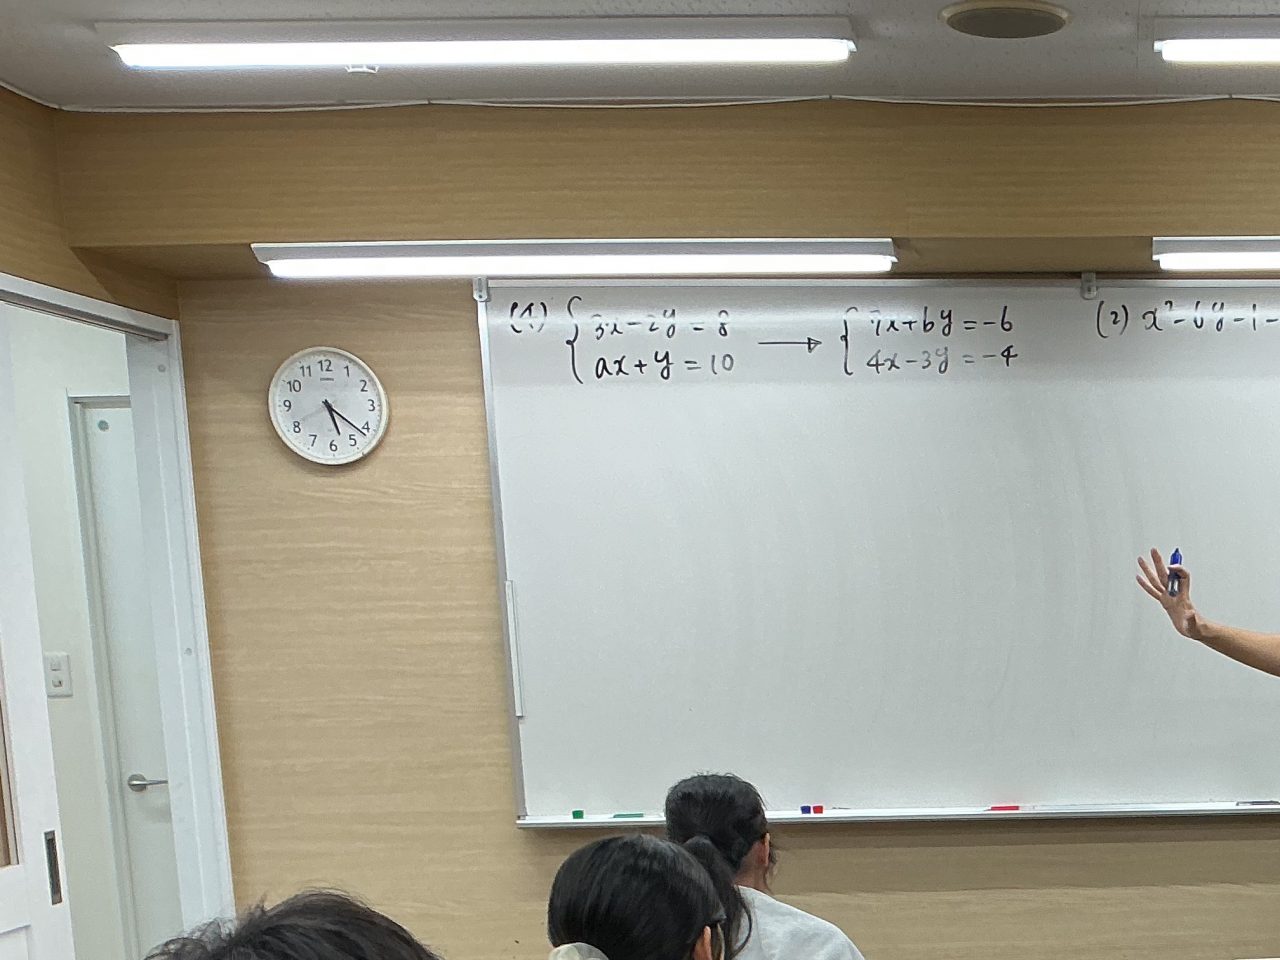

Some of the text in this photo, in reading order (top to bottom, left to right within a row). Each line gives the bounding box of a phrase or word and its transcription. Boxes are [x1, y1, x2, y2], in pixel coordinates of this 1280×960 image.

[1096, 300, 1129, 338] (2)
[300, 365, 312, 377] 11
[318, 359, 333, 372] 12
[344, 366, 350, 378] 1
[287, 379, 302, 393] 10
[360, 379, 368, 392] 2
[283, 400, 292, 412] 9
[368, 399, 376, 412] 3
[292, 420, 301, 433] 8
[361, 421, 370, 433] 4
[309, 434, 317, 447] 7
[329, 440, 338, 452] 6
[349, 434, 357, 447] 5
